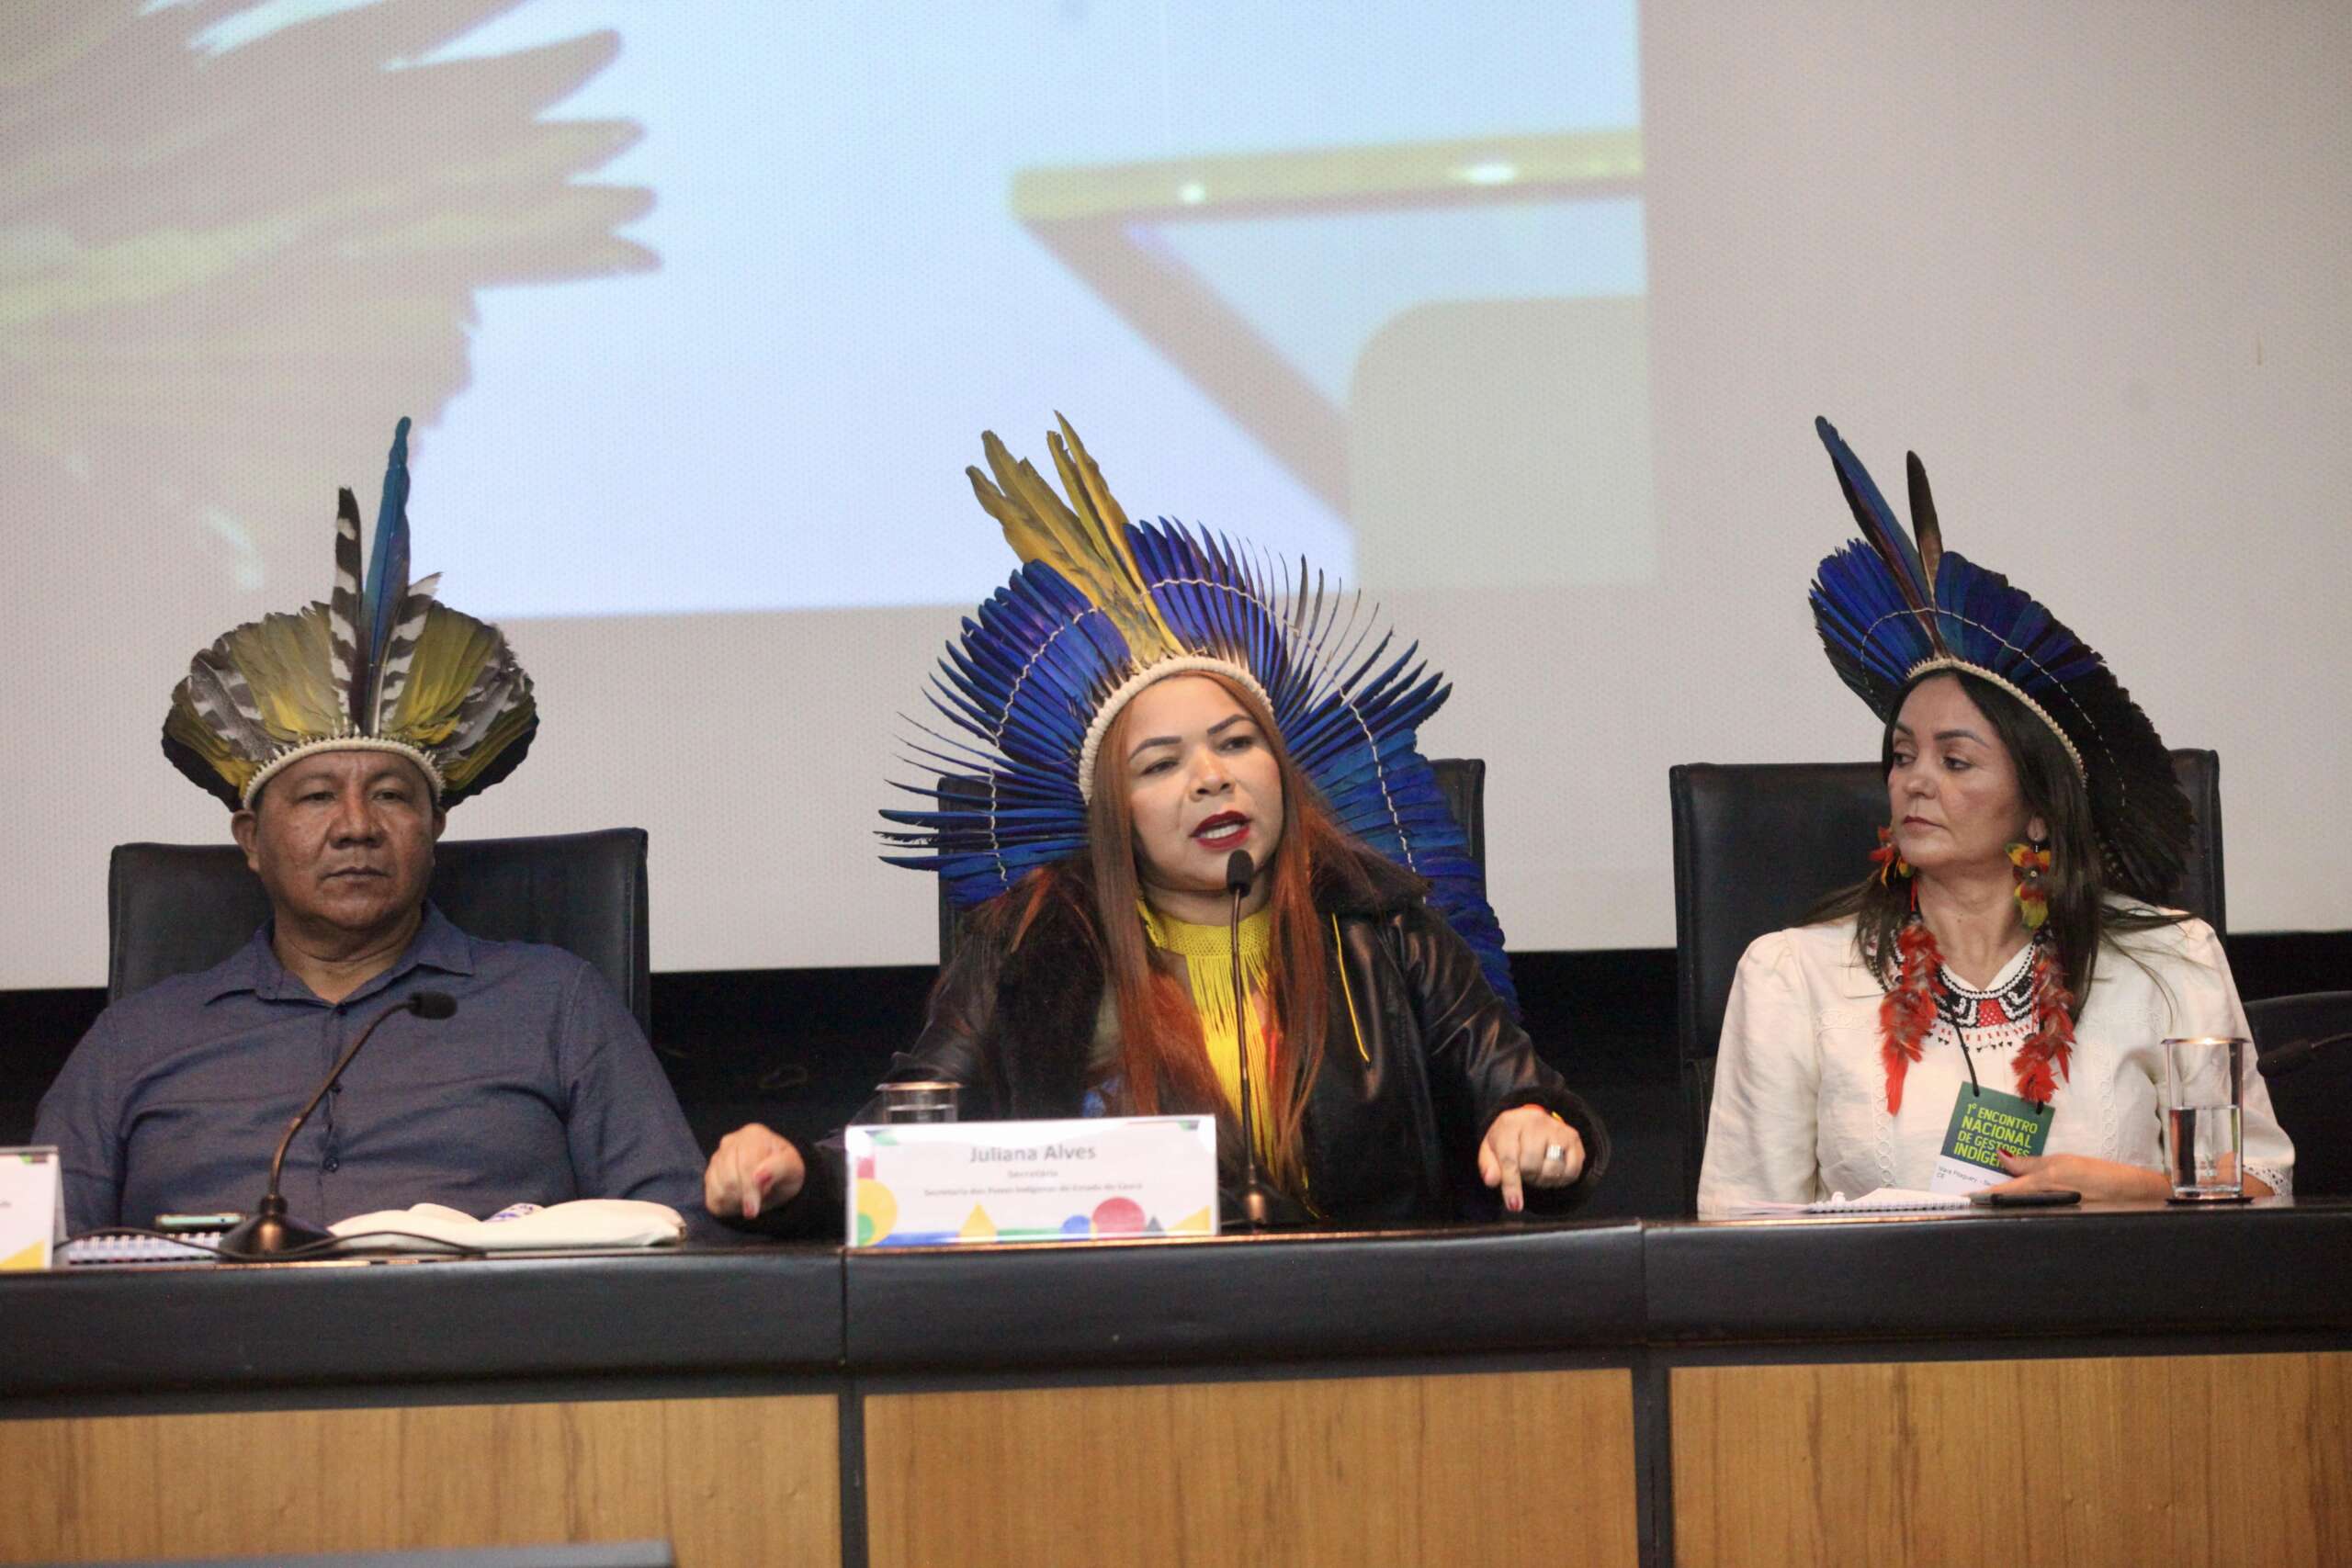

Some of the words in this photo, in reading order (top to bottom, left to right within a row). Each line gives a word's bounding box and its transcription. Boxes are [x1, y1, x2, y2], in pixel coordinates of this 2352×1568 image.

[1962, 1116, 2032, 1148] NACIONAL
[1977, 1108, 2038, 1134] ENCONTRO
[1958, 1131, 1973, 1144] DE
[970, 1145, 1037, 1164] Juliana
[1045, 1143, 1096, 1161] Alves
